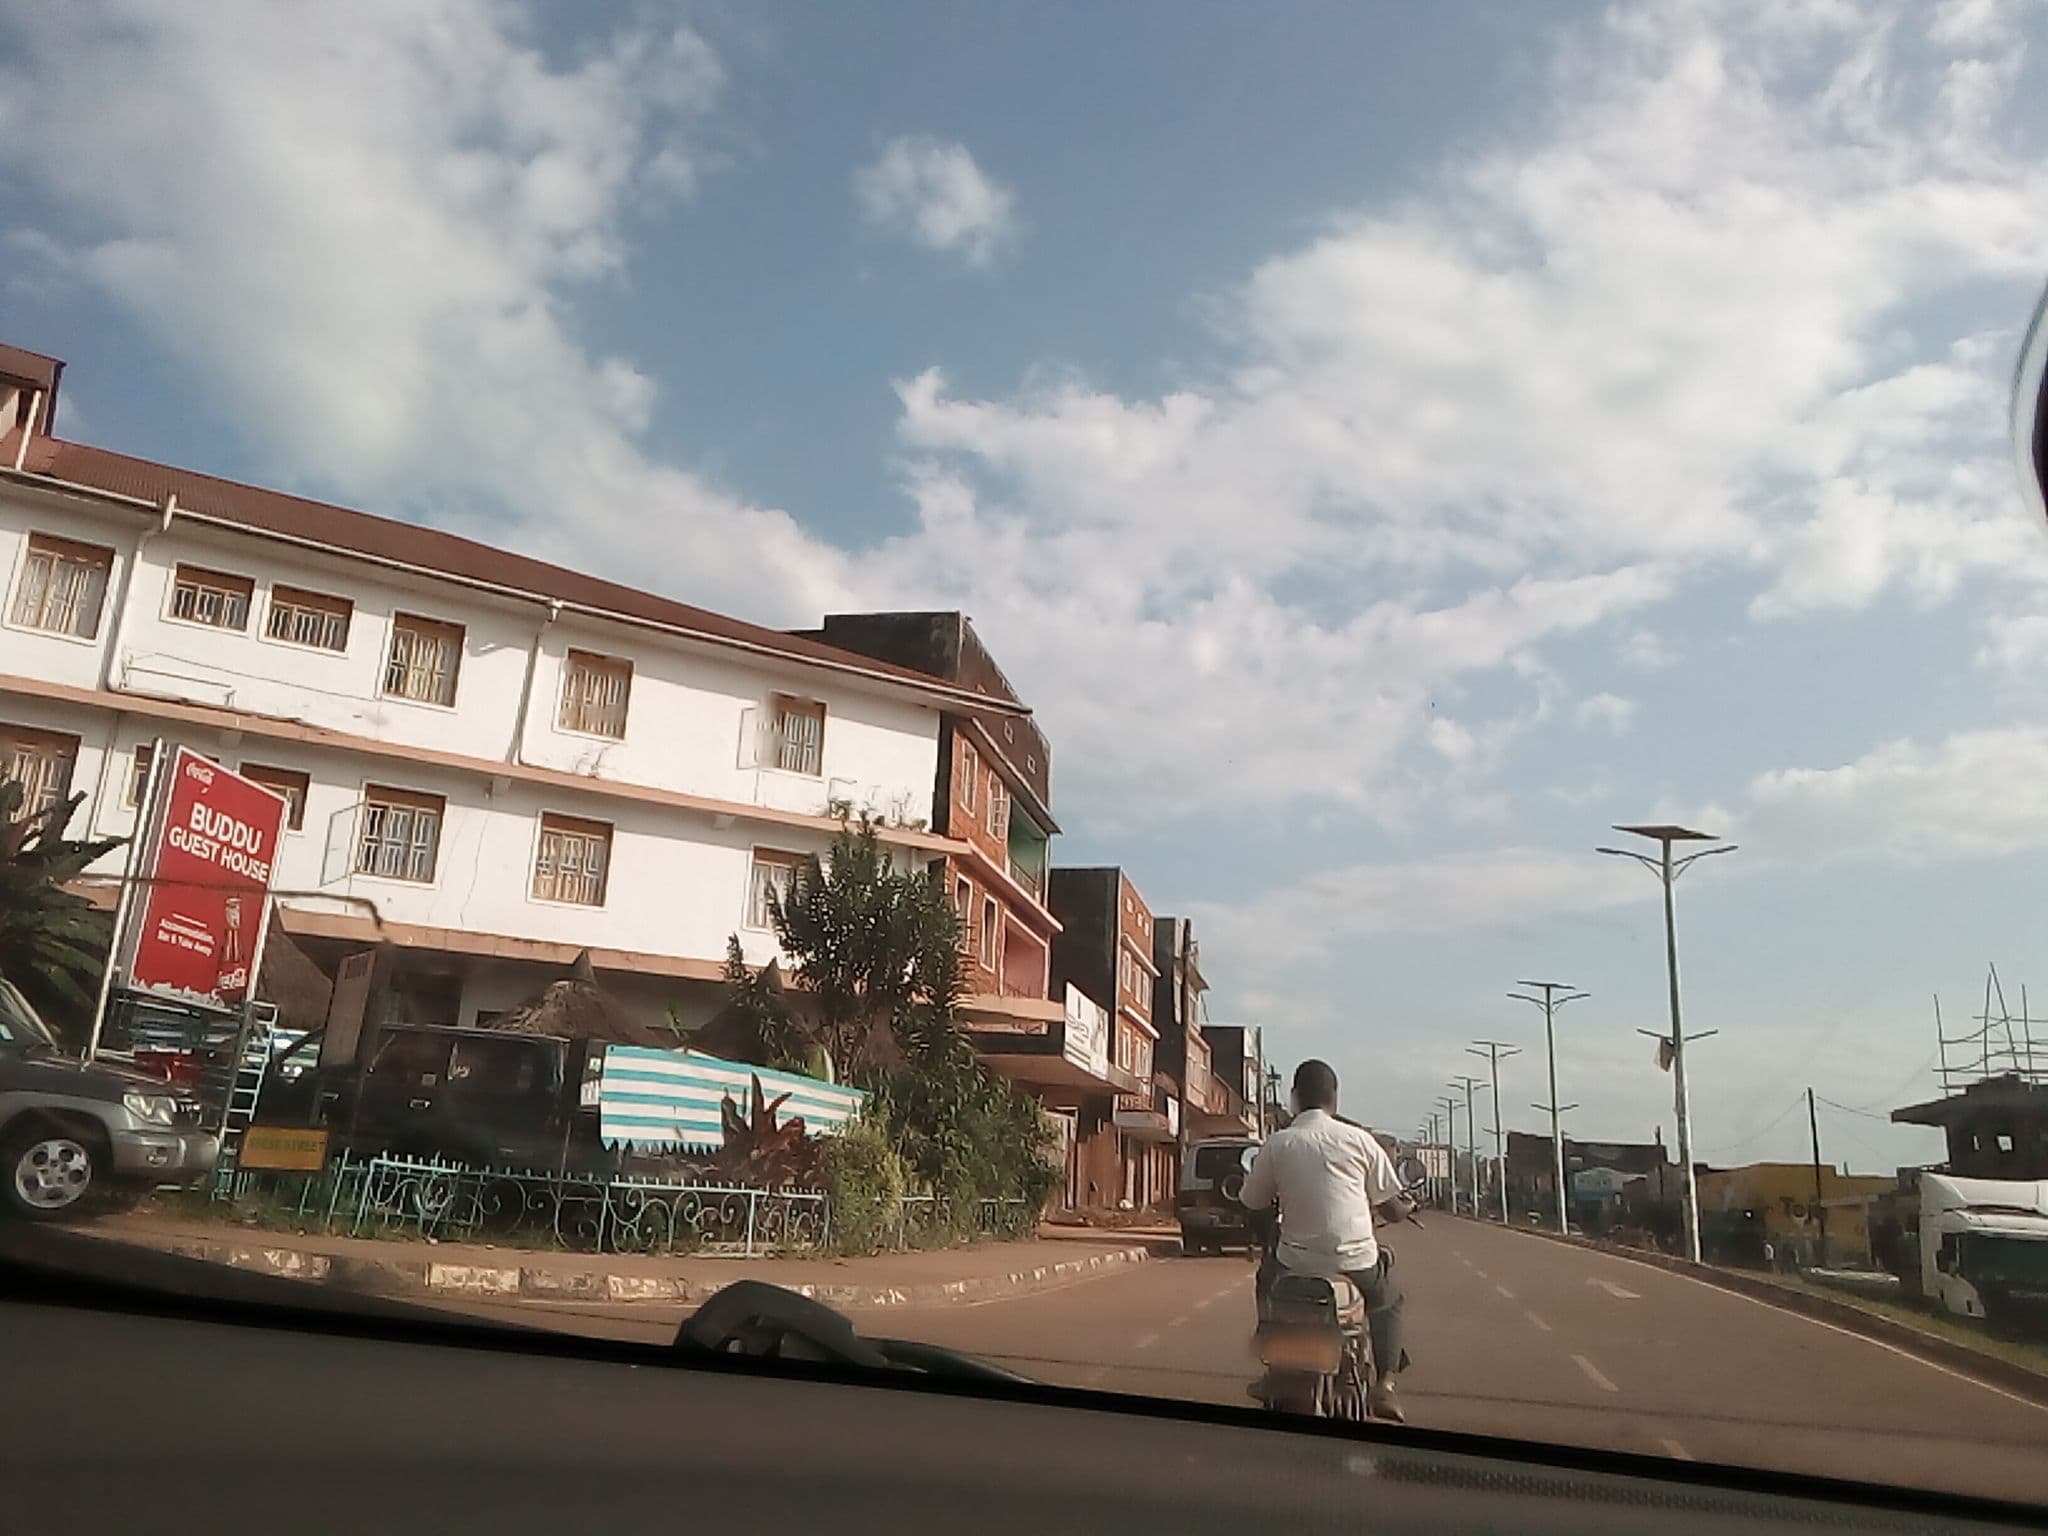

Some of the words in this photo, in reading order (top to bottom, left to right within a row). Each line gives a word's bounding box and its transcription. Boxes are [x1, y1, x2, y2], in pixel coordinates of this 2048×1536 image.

[169, 826, 221, 862] GUEST
[220, 846, 270, 883] HOUSE
[190, 802, 263, 854] BUDDU
